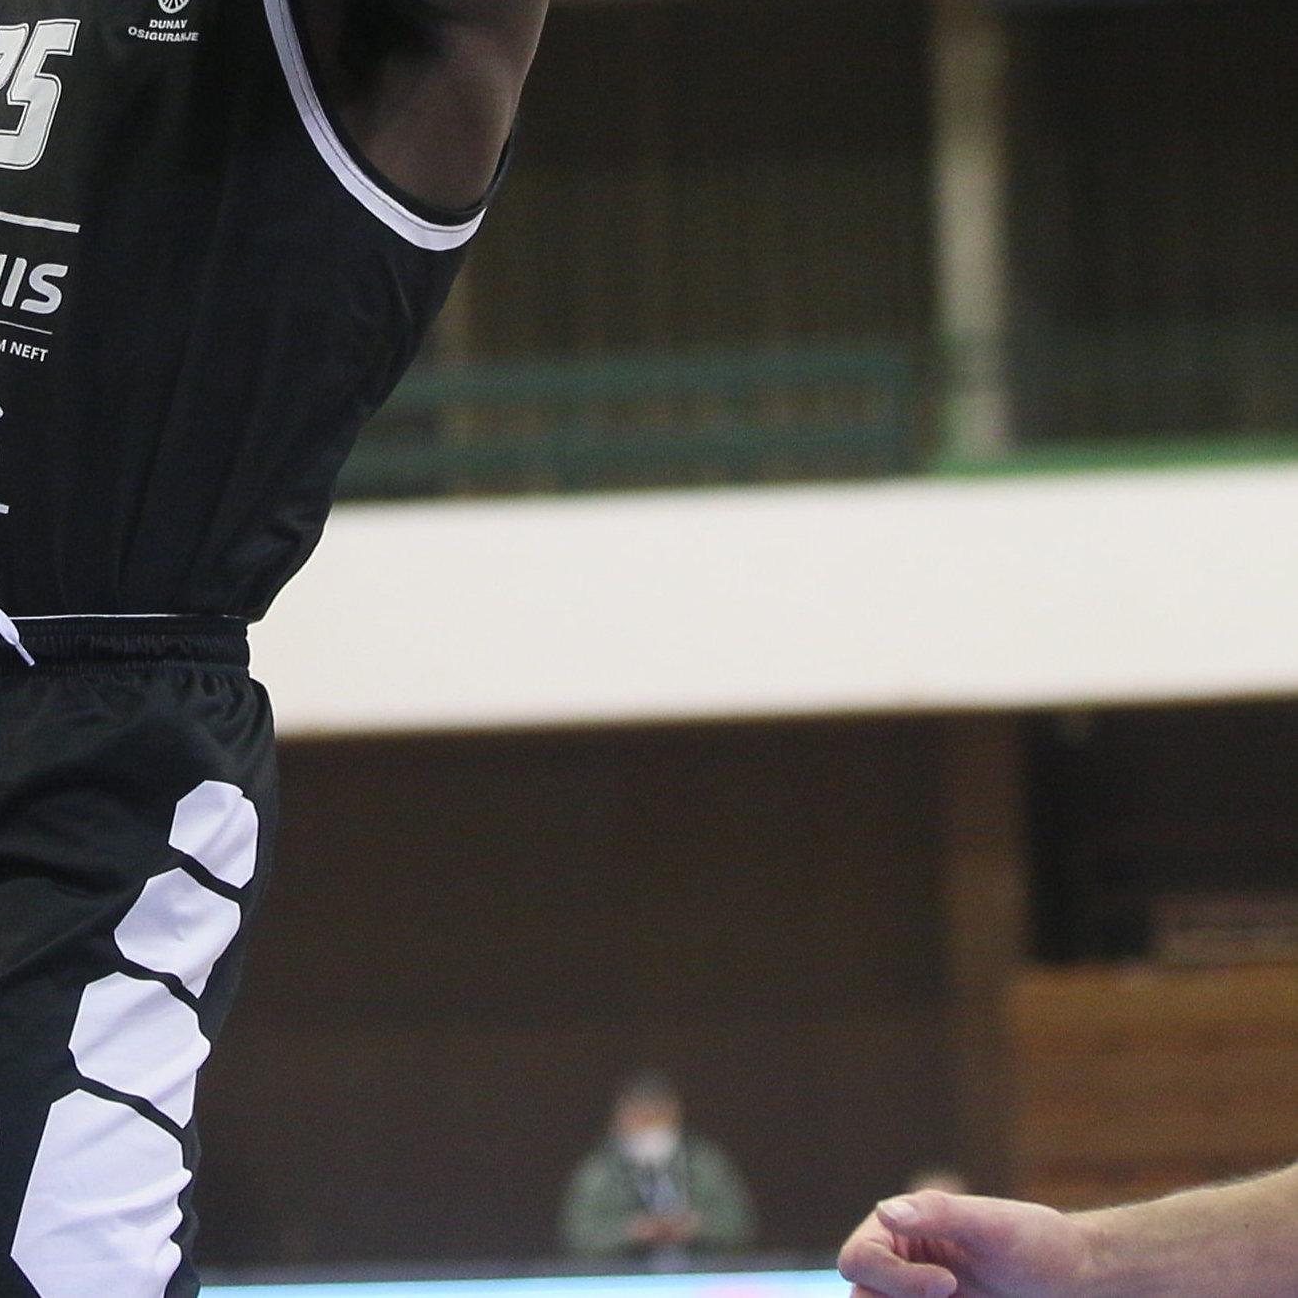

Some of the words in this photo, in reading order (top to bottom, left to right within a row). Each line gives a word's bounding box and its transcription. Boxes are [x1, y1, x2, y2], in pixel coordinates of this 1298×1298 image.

[149, 19, 188, 29] DUNAV
[128, 26, 200, 42] OSIGURANJE
[9, 341, 49, 363] NEFT
